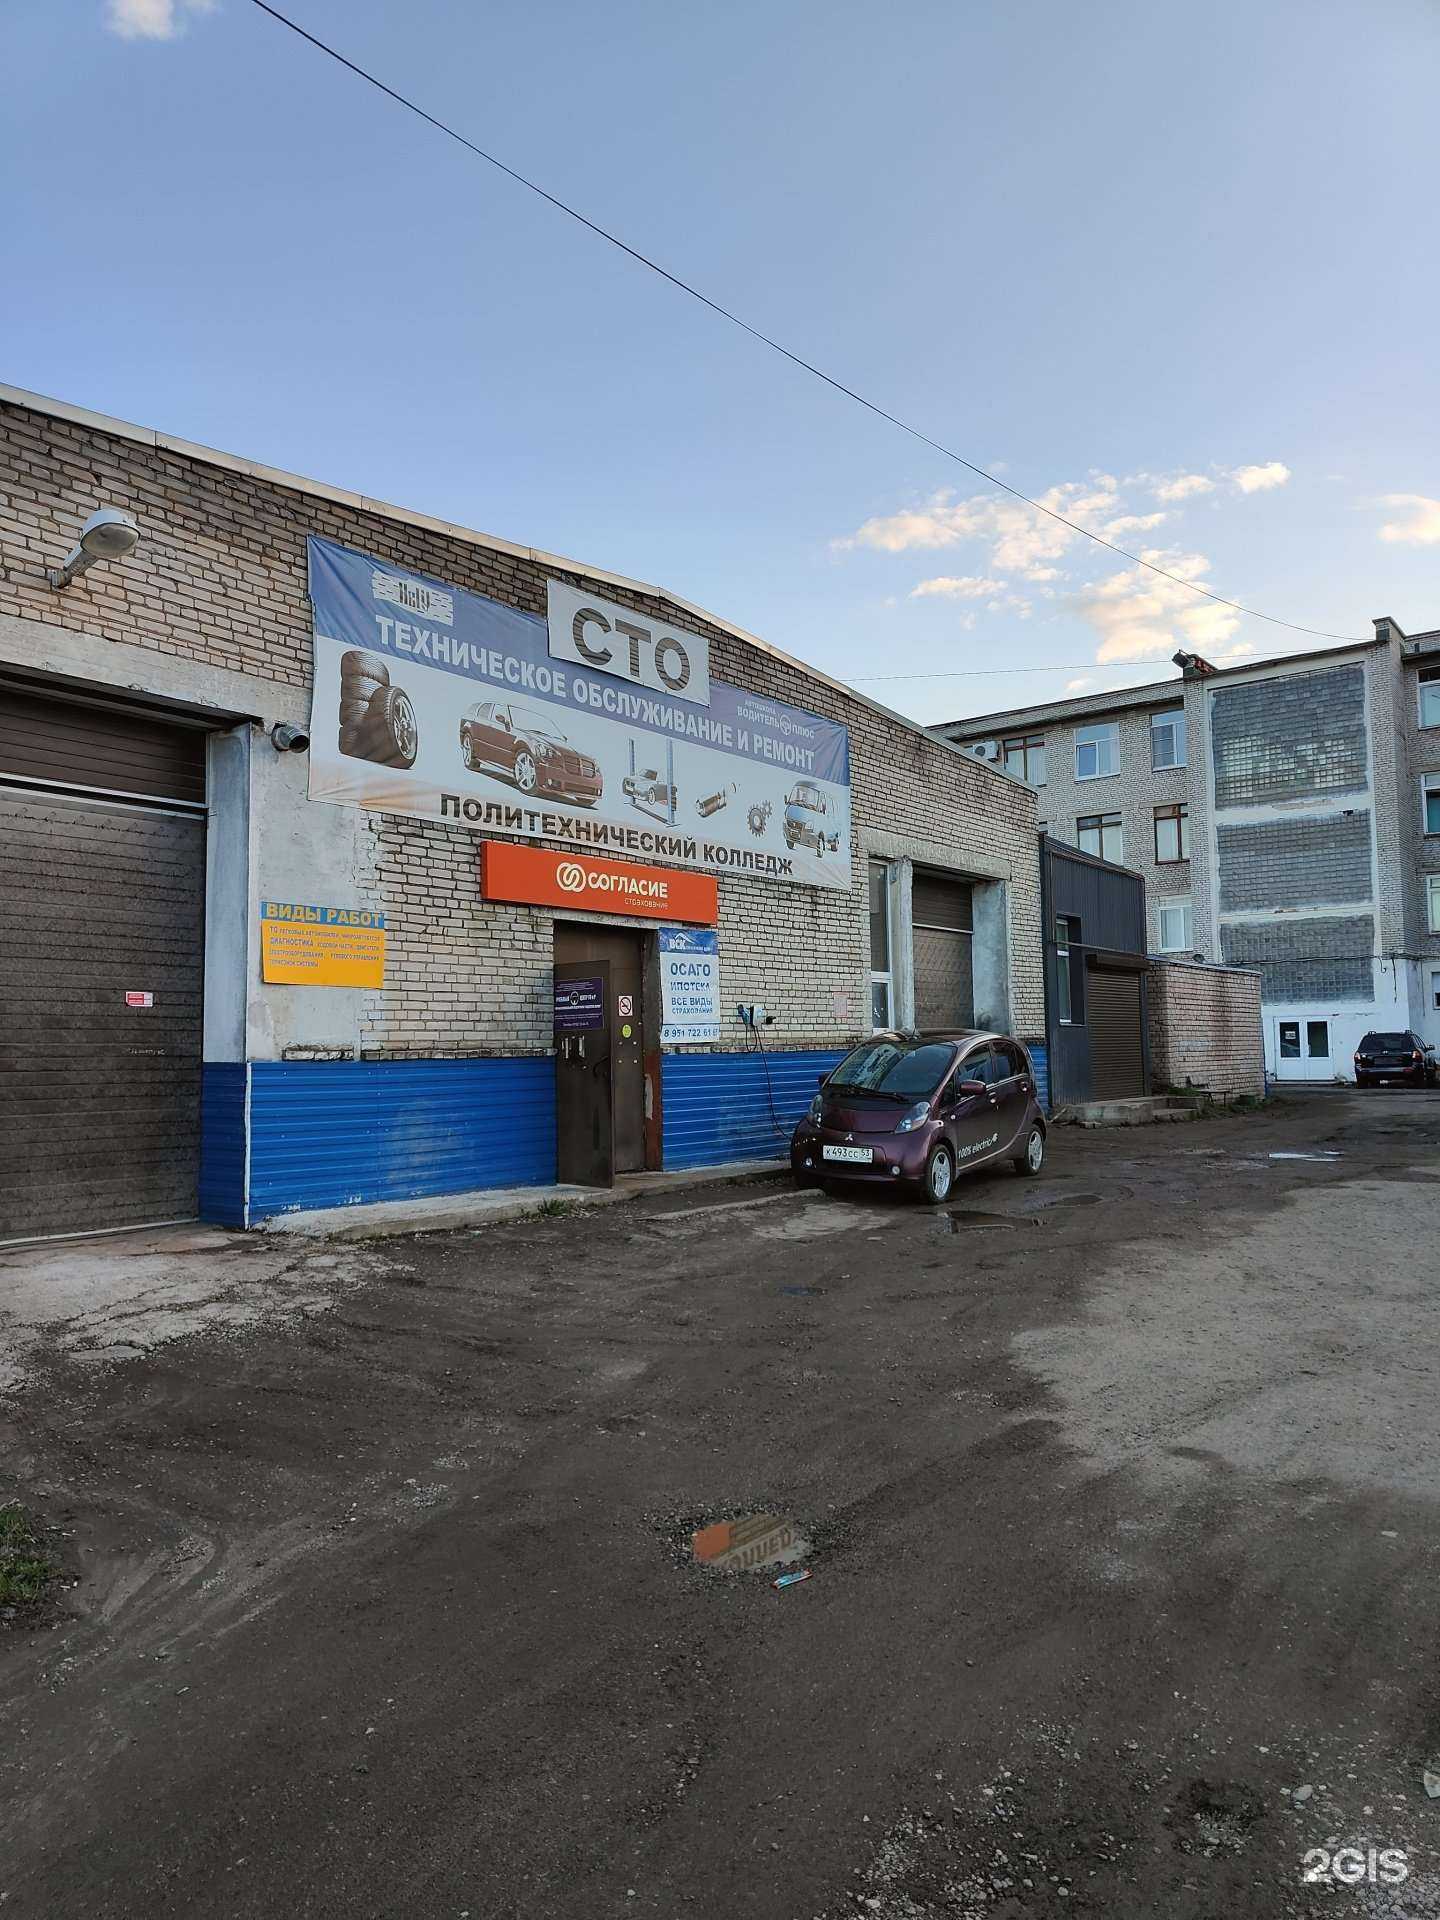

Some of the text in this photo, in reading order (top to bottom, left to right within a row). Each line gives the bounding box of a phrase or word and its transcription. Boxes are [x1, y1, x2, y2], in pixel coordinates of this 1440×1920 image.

[572, 607, 691, 692] СТО
[375, 615, 815, 770] ТЕХНИЧЕСКОЕ ОБСЛУЖИВАНИЕ И РЕМОНТ
[737, 705, 780, 728] ВОДИТЕЛЬ
[441, 793, 794, 876] ПОЛИТЕХНИЧЕСКИЙ КОЛЛЕДЖ
[587, 871, 669, 899] СОГЛАСИЕ
[266, 903, 380, 928] ВИДЫ РАБОТ
[670, 962, 711, 977] ОСАГО
[671, 981, 710, 992] ИПОТЕКА
[671, 997, 713, 1008] ВСЕ ВИДЫ
[663, 1029, 670, 1038] 8
[672, 1029, 685, 1038] 951
[688, 1029, 701, 1037] 722
